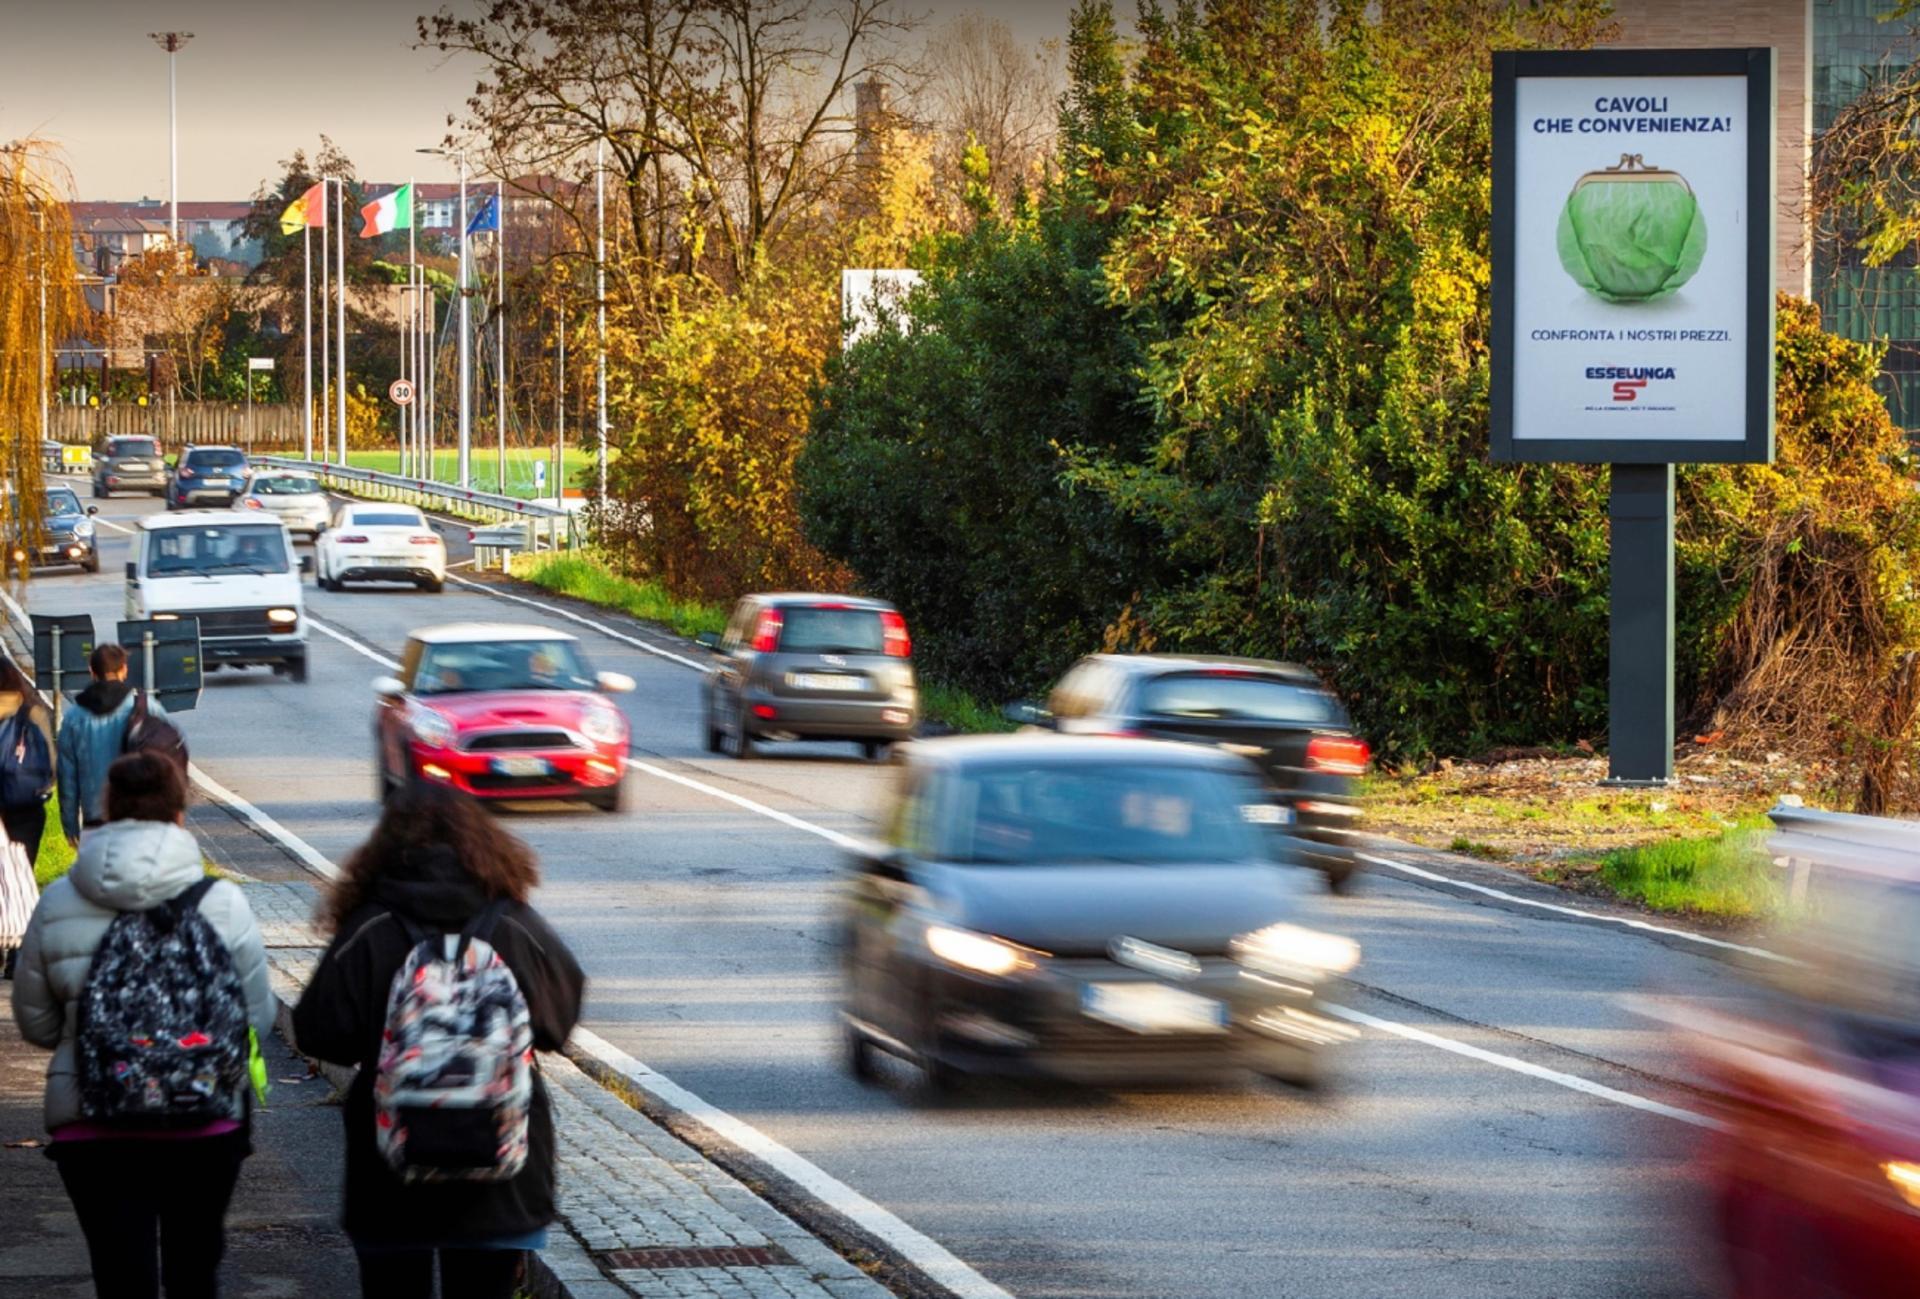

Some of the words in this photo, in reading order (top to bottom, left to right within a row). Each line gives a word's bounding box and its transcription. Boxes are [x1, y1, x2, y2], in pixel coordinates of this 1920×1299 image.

[1595, 97, 1668, 113] CAVOLI
[1533, 118, 1573, 133] CHE
[1578, 117, 1731, 133] CONVENIENZA!
[1531, 329, 1615, 341] CONFRONTA
[1627, 329, 1676, 341] NOSTRI
[1680, 329, 1732, 342] PREZZI.
[1586, 367, 1675, 380] ESSELUNGA
[396, 386, 410, 398] 30
